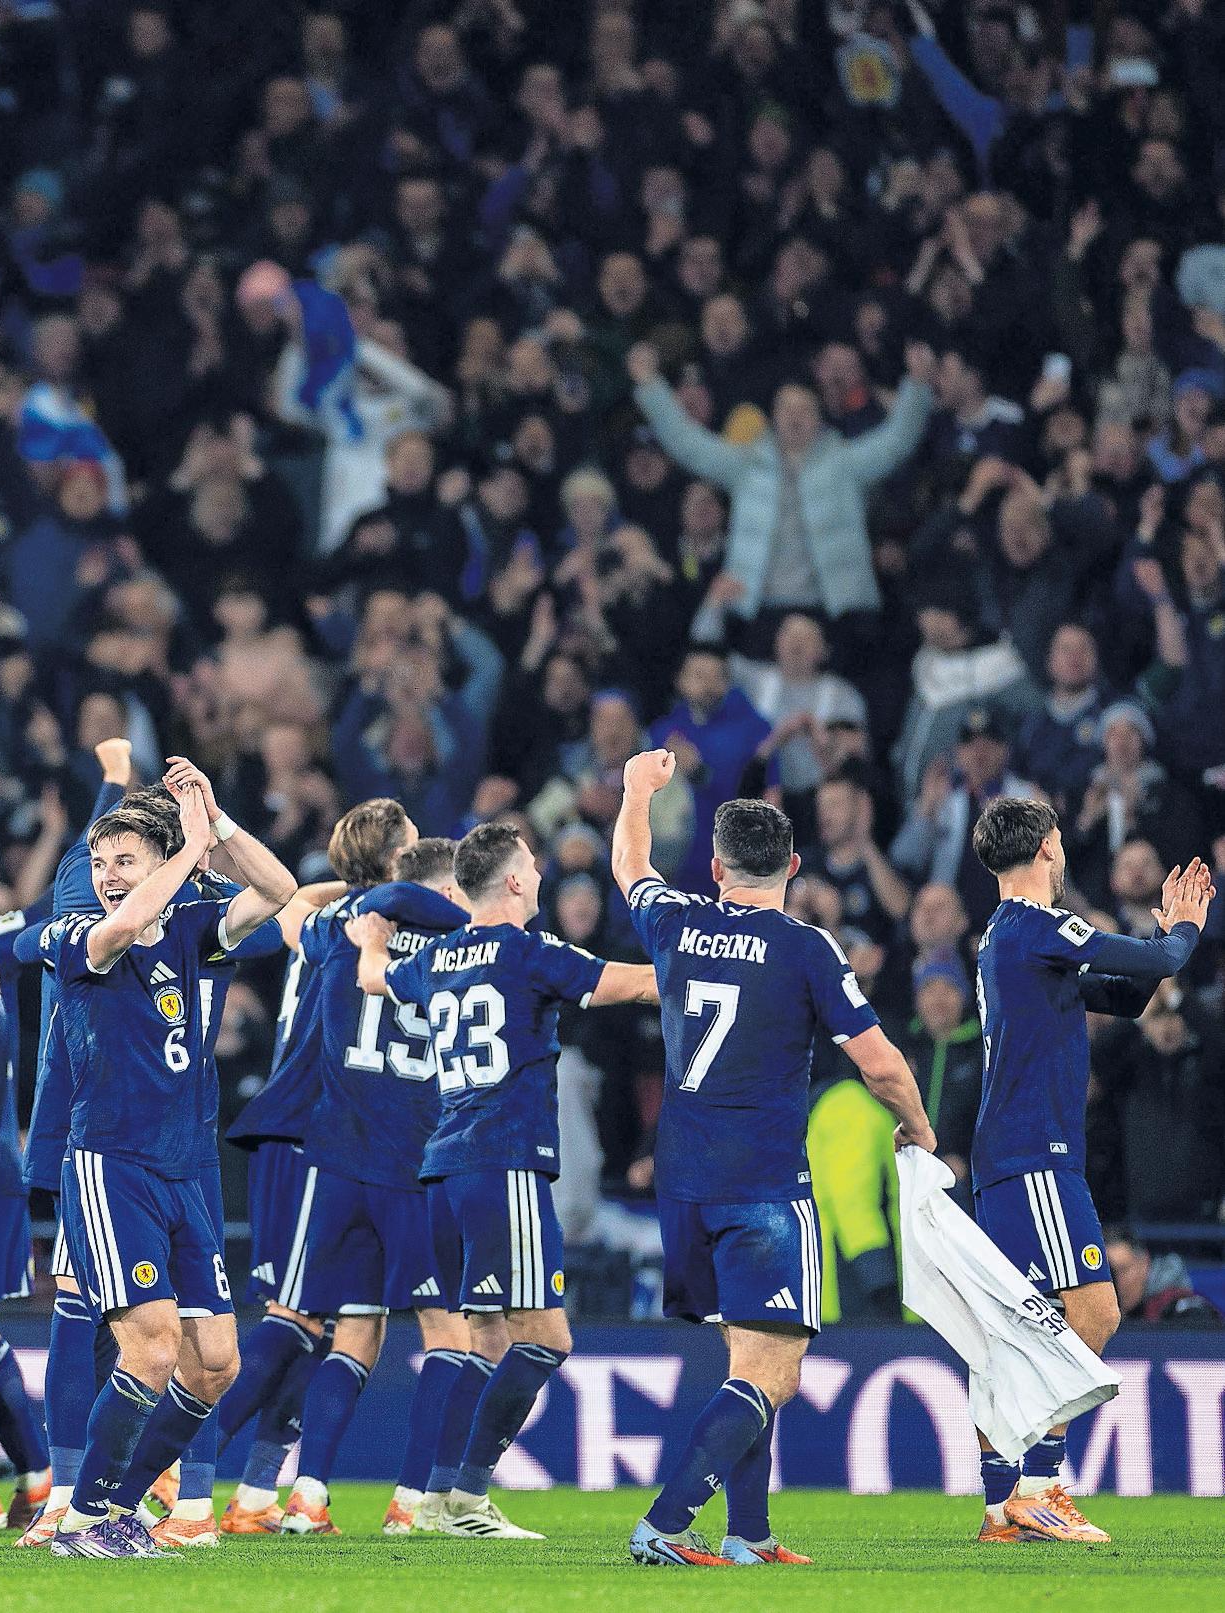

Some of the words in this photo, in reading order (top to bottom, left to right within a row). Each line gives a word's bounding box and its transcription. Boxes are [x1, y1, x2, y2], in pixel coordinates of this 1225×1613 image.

[677, 927, 768, 964] McGINN
[164, 1026, 191, 1074] 6
[428, 983, 510, 1095] 23
[679, 979, 740, 1093] 7
